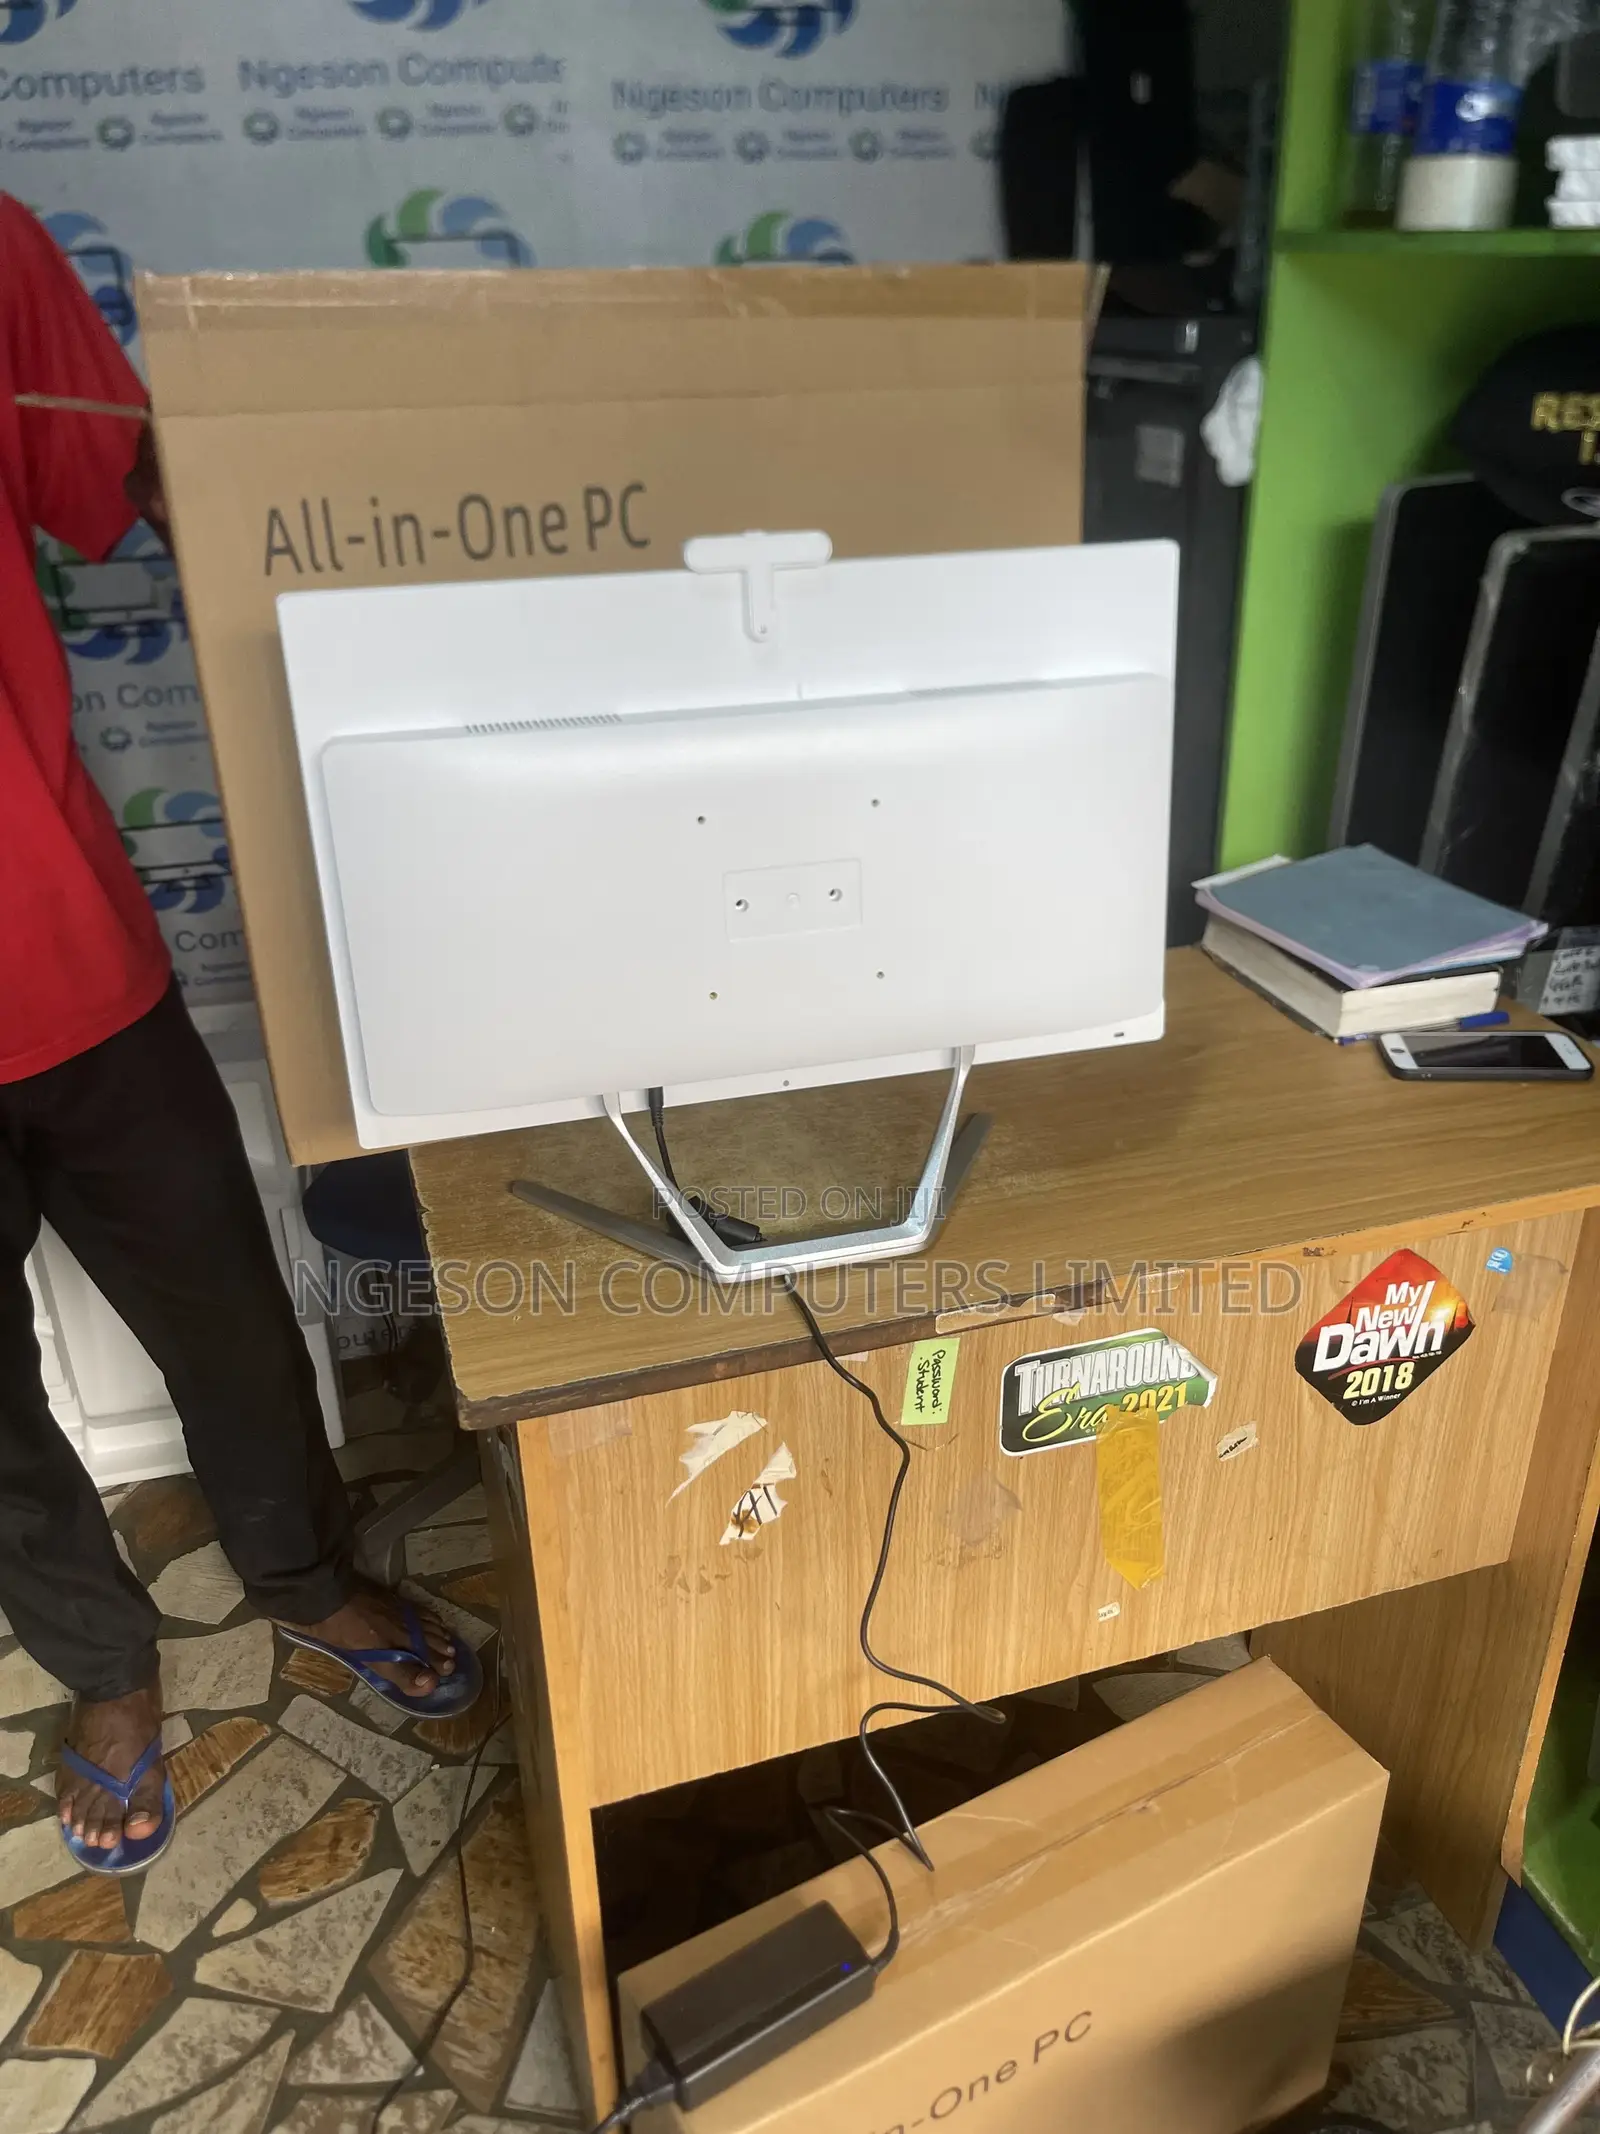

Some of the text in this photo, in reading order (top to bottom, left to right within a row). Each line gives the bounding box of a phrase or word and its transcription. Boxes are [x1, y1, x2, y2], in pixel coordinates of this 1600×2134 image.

[611, 79, 752, 120] Ngeson
[757, 77, 949, 120] Computers
[264, 479, 652, 577] All-in-One PC
[1384, 1281, 1425, 1306] My
[1312, 1281, 1447, 1373] Dawn
[1354, 1306, 1418, 1334] New
[1342, 1361, 1416, 1400] 2018
[1377, 1392, 1402, 1402] Winner
[1022, 1380, 1187, 1442] Era 2021
[1033, 2010, 1093, 2064] PC
